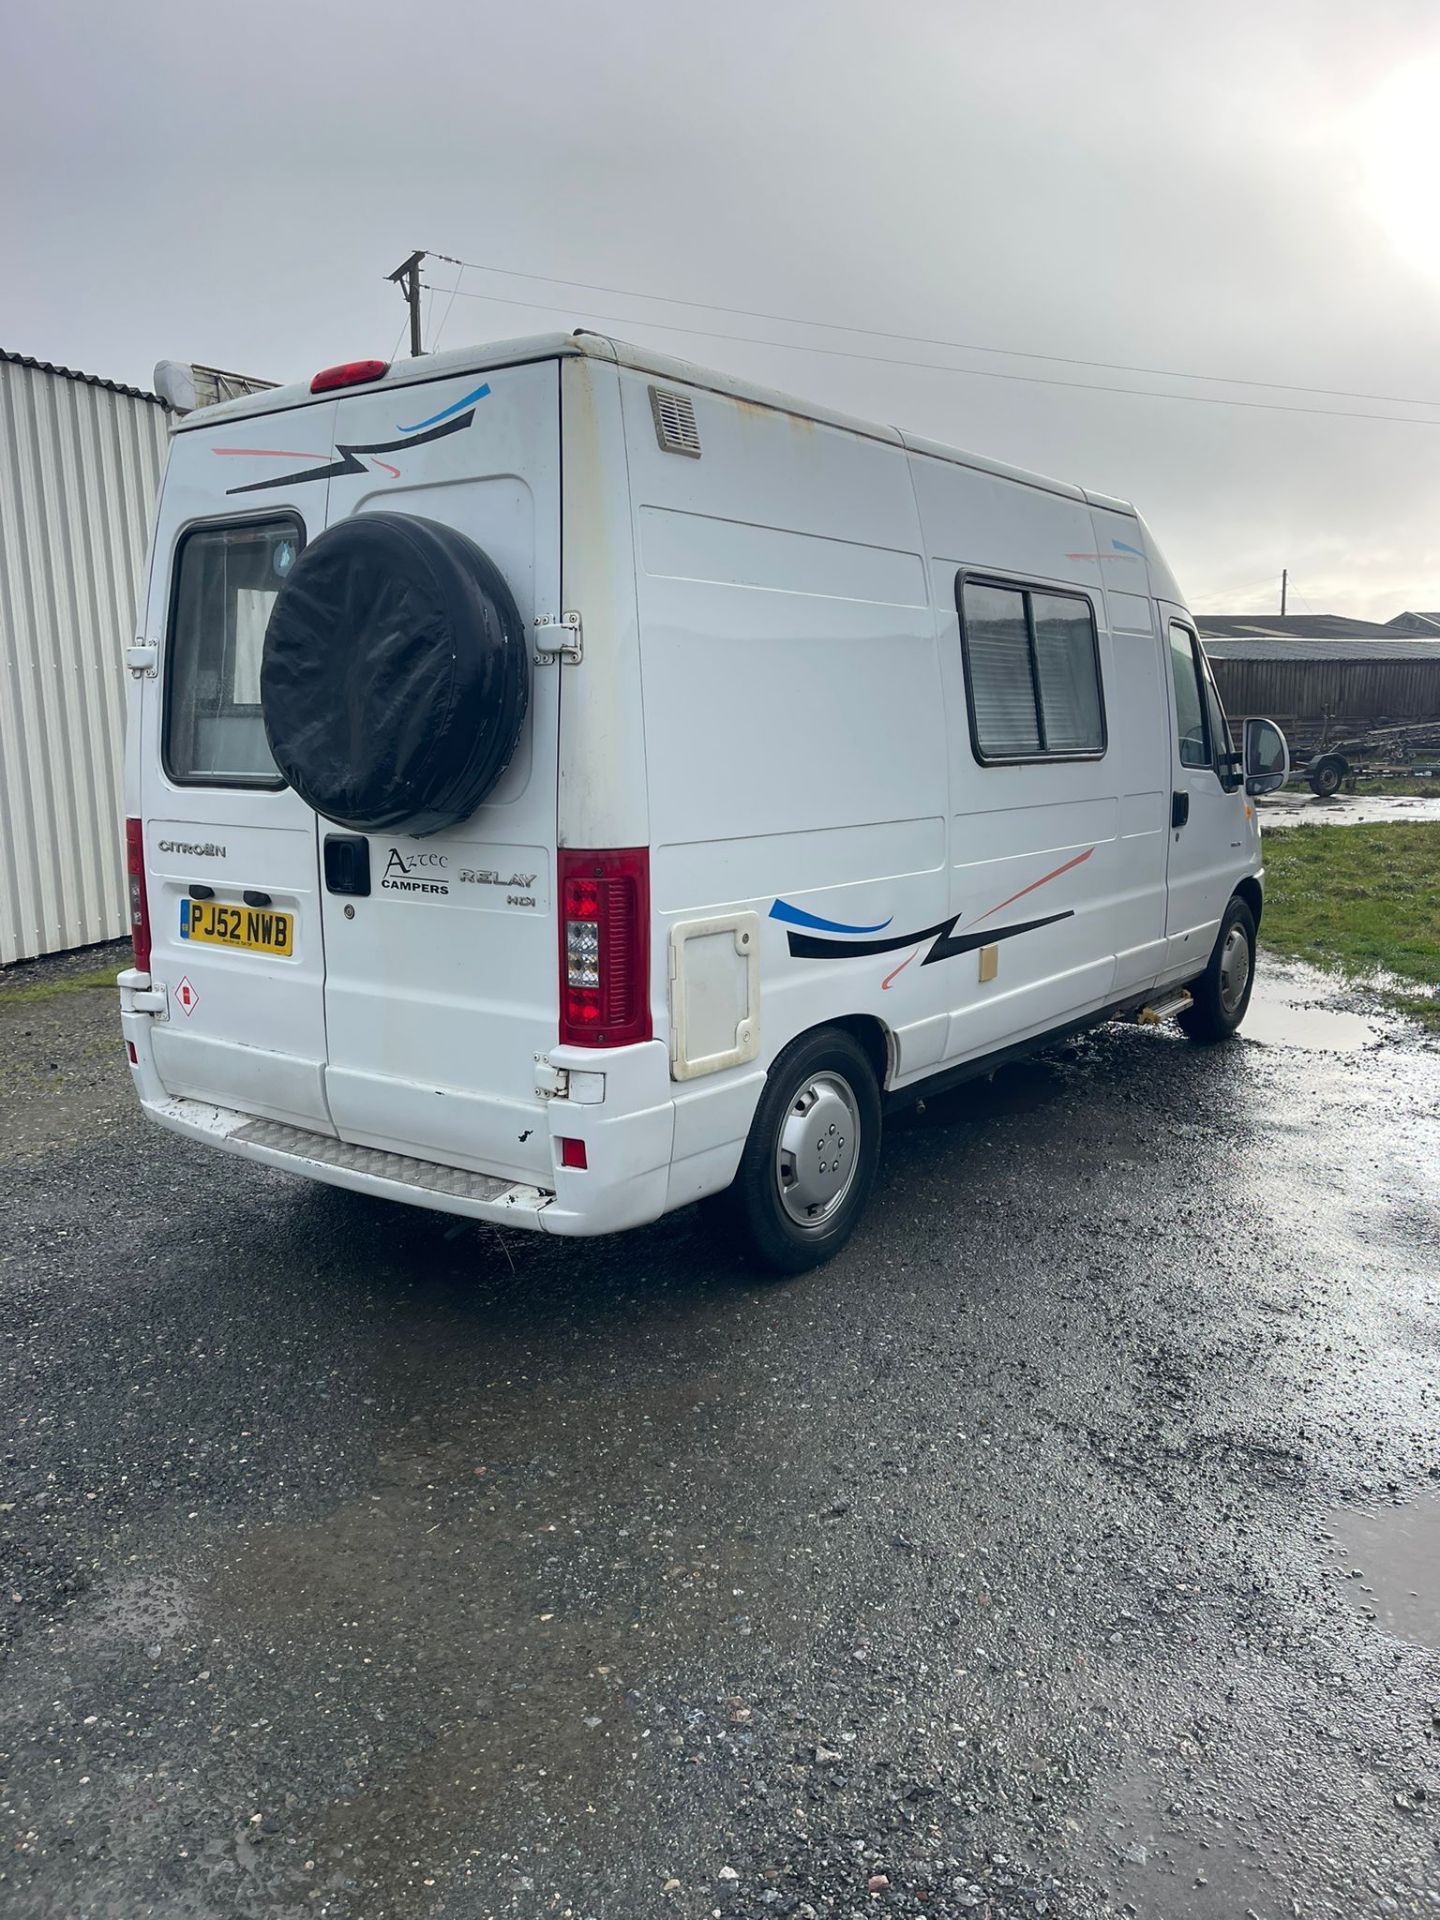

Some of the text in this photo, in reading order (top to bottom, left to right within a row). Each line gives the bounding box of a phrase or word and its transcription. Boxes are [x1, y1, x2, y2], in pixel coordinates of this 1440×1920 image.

[383, 848, 449, 878] Aztec
[381, 879, 449, 895] CAMPERS
[459, 868, 538, 889] RELAY
[191, 904, 288, 948] PJ52 NWB
